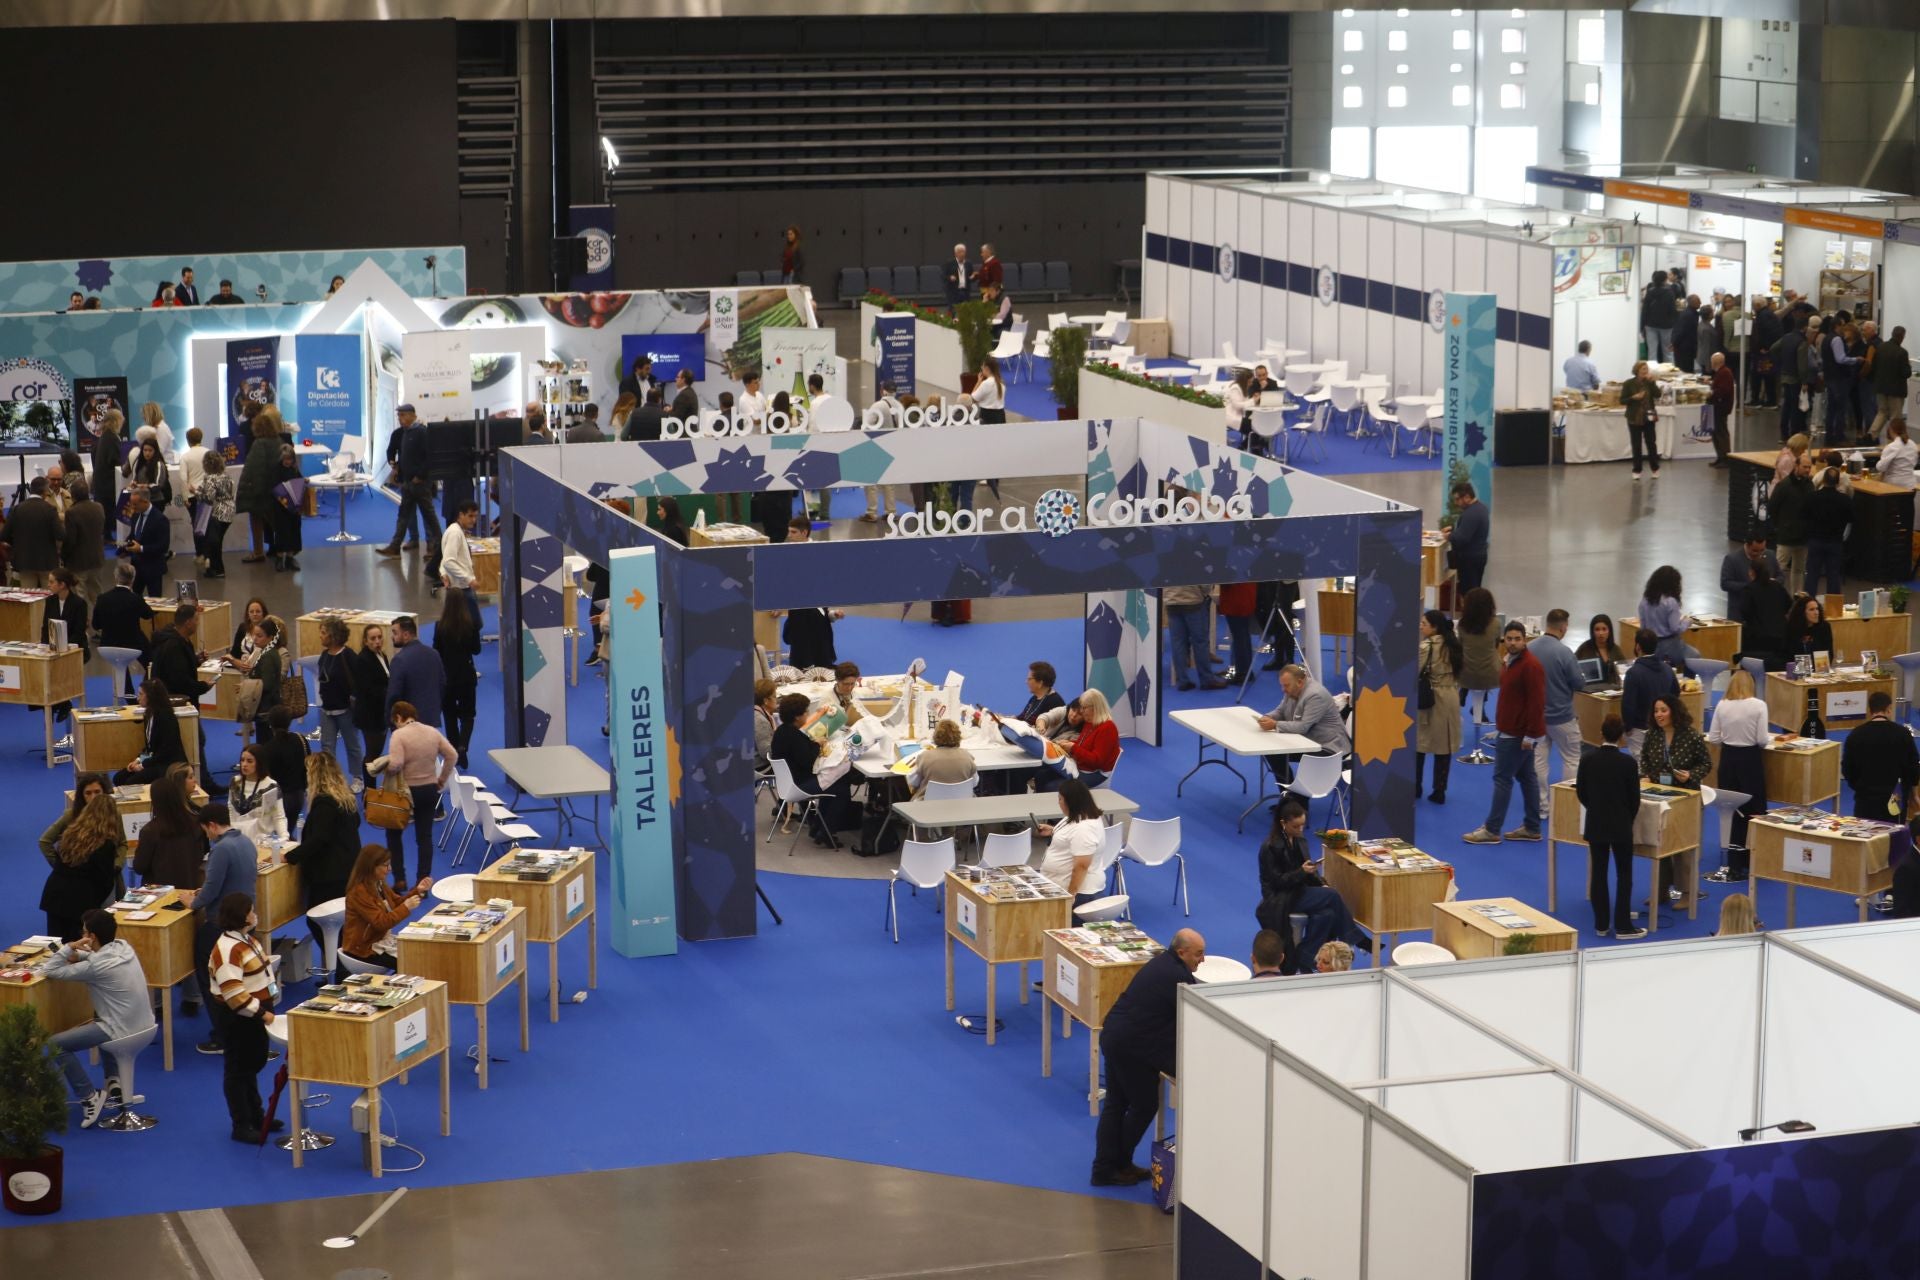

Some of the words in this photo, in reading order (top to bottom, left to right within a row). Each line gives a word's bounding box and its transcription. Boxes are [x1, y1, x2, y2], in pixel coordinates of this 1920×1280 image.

[1450, 335, 1460, 381] ZONA
[307, 391, 350, 400] Diputación
[884, 501, 994, 539] sabor
[1000, 506, 1027, 532] a
[631, 685, 657, 831] TALLERES
